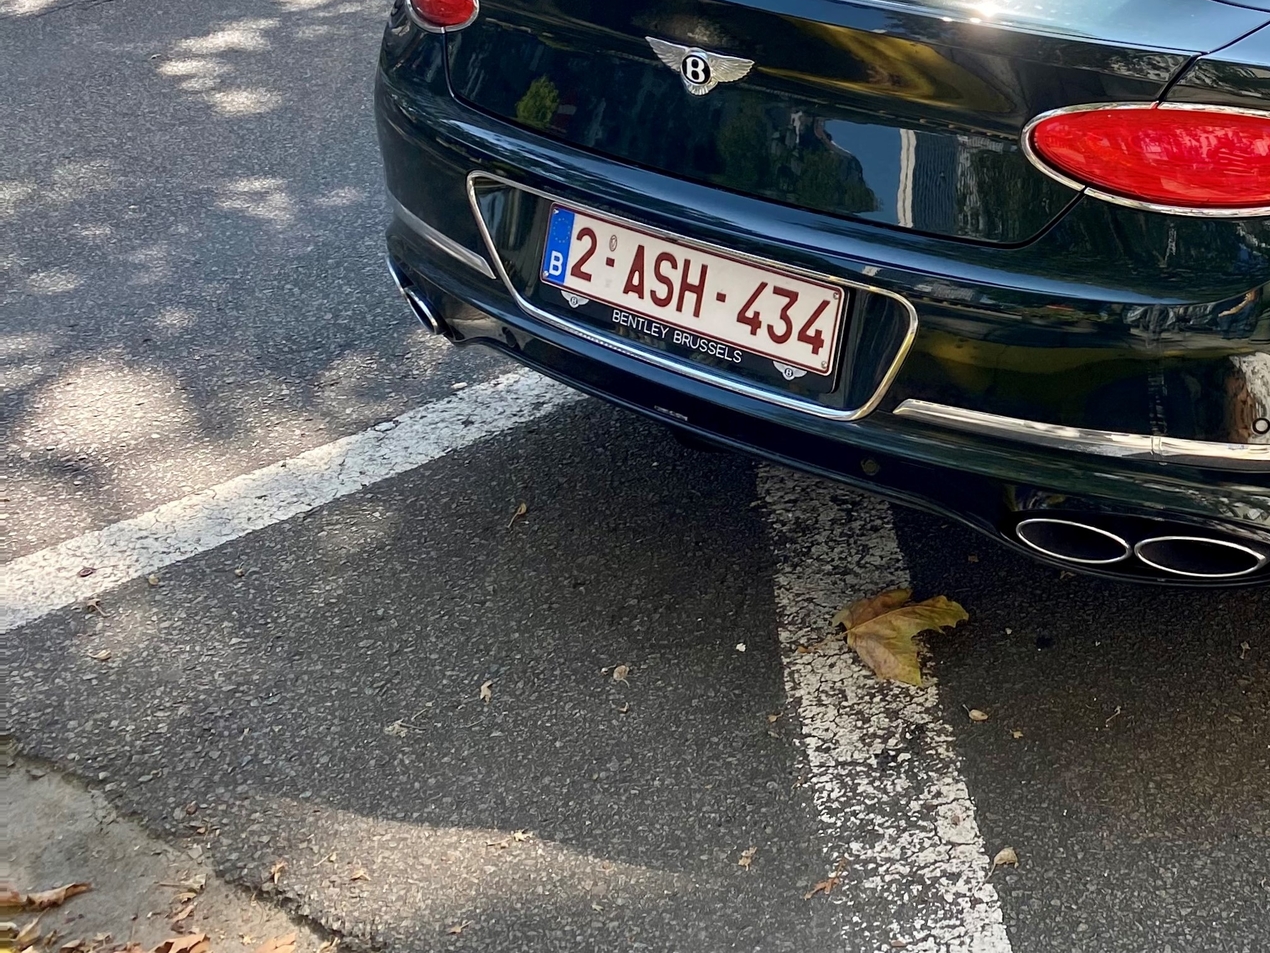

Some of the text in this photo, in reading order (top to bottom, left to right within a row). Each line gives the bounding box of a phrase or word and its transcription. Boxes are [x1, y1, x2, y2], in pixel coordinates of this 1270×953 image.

[686, 56, 705, 83] B
[549, 251, 564, 277] B
[612, 310, 743, 364] BENTLEY BRUSSELS
